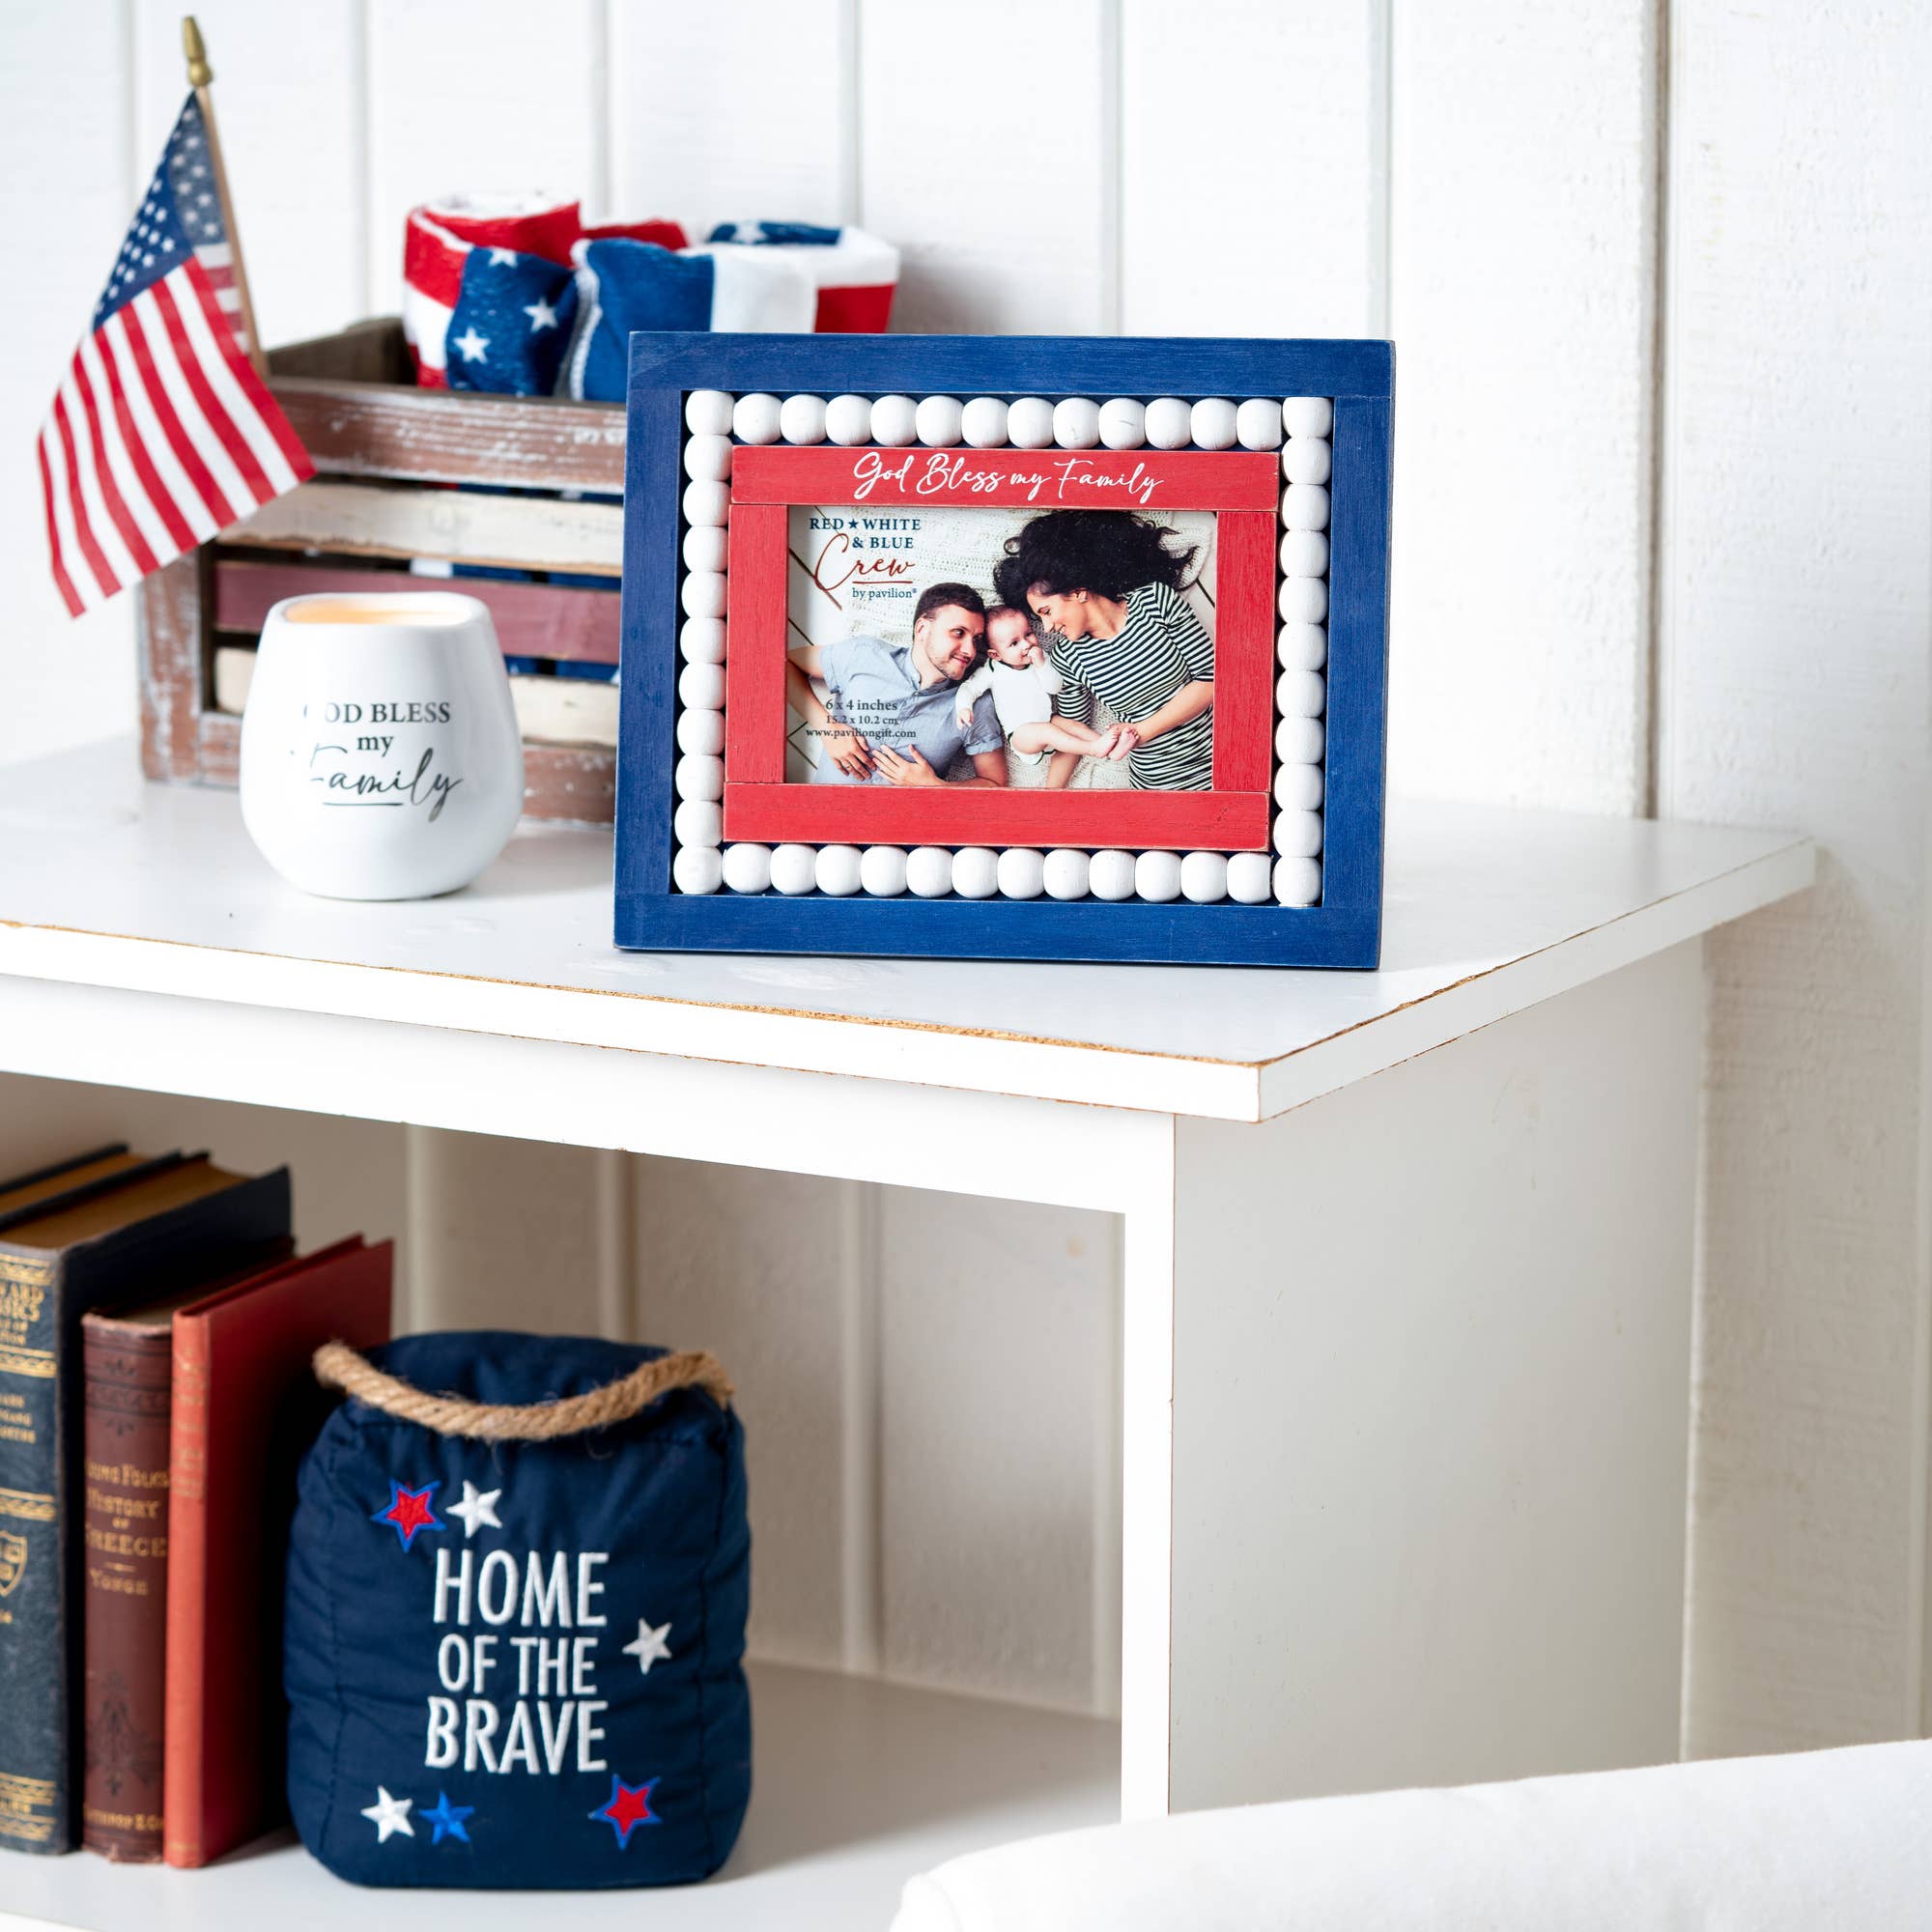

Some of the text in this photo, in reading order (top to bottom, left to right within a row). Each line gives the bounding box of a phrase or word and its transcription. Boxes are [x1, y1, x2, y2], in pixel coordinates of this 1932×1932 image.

[853, 451, 1164, 504] God Bless my Family
[810, 518, 921, 530] RED WHITE
[852, 537, 914, 549] & BLUE
[814, 532, 916, 591] Crew
[852, 587, 866, 599] by
[303, 702, 451, 724] OD BLESS
[826, 699, 833, 710] 6
[846, 699, 854, 710] 4
[857, 699, 897, 710] inches
[827, 715, 847, 724] 15.2
[859, 716, 880, 724] 10.2
[806, 728, 917, 740] www.paviliongift.com
[356, 736, 394, 757] my
[434, 1548, 610, 1628] HOME
[438, 1634, 598, 1696] OF THE
[425, 1696, 609, 1775] BRAVE
